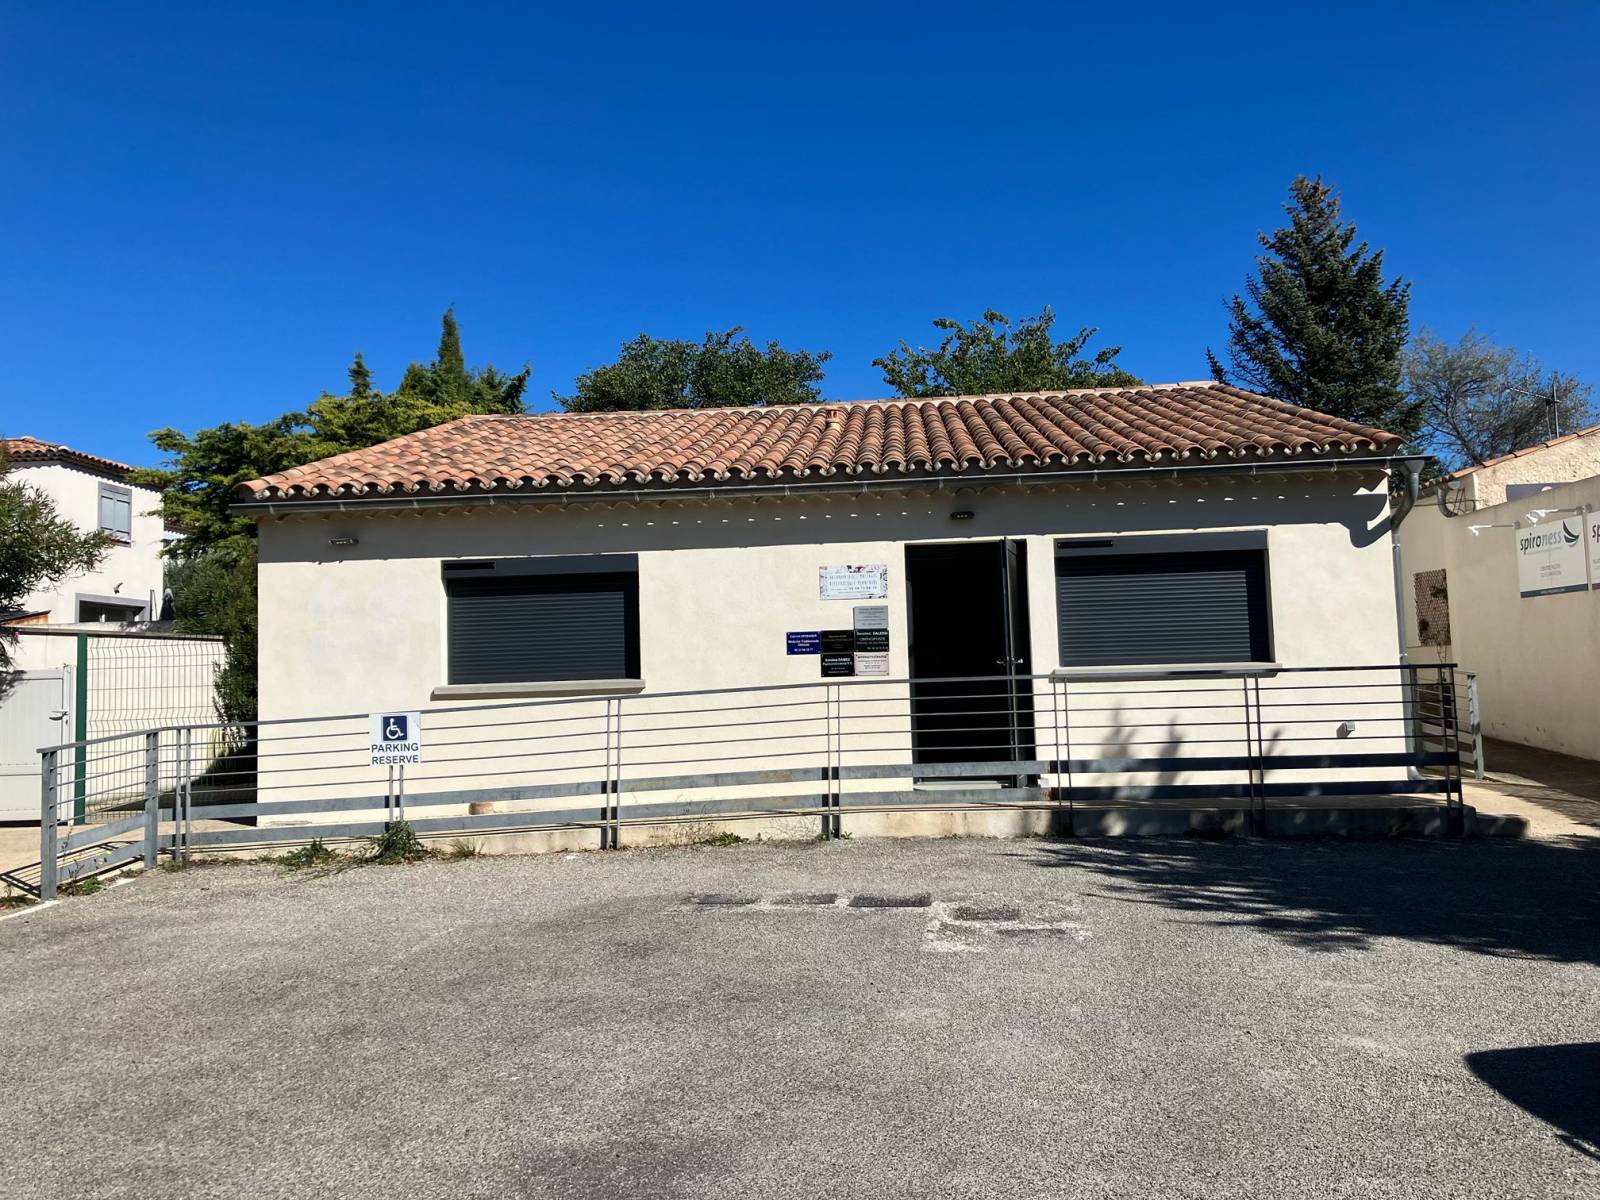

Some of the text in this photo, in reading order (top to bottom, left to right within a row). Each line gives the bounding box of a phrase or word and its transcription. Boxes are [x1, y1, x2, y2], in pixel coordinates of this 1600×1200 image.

[1520, 530, 1563, 555] spironess
[371, 742, 419, 753] PARKING
[371, 755, 419, 765] RESERVE
